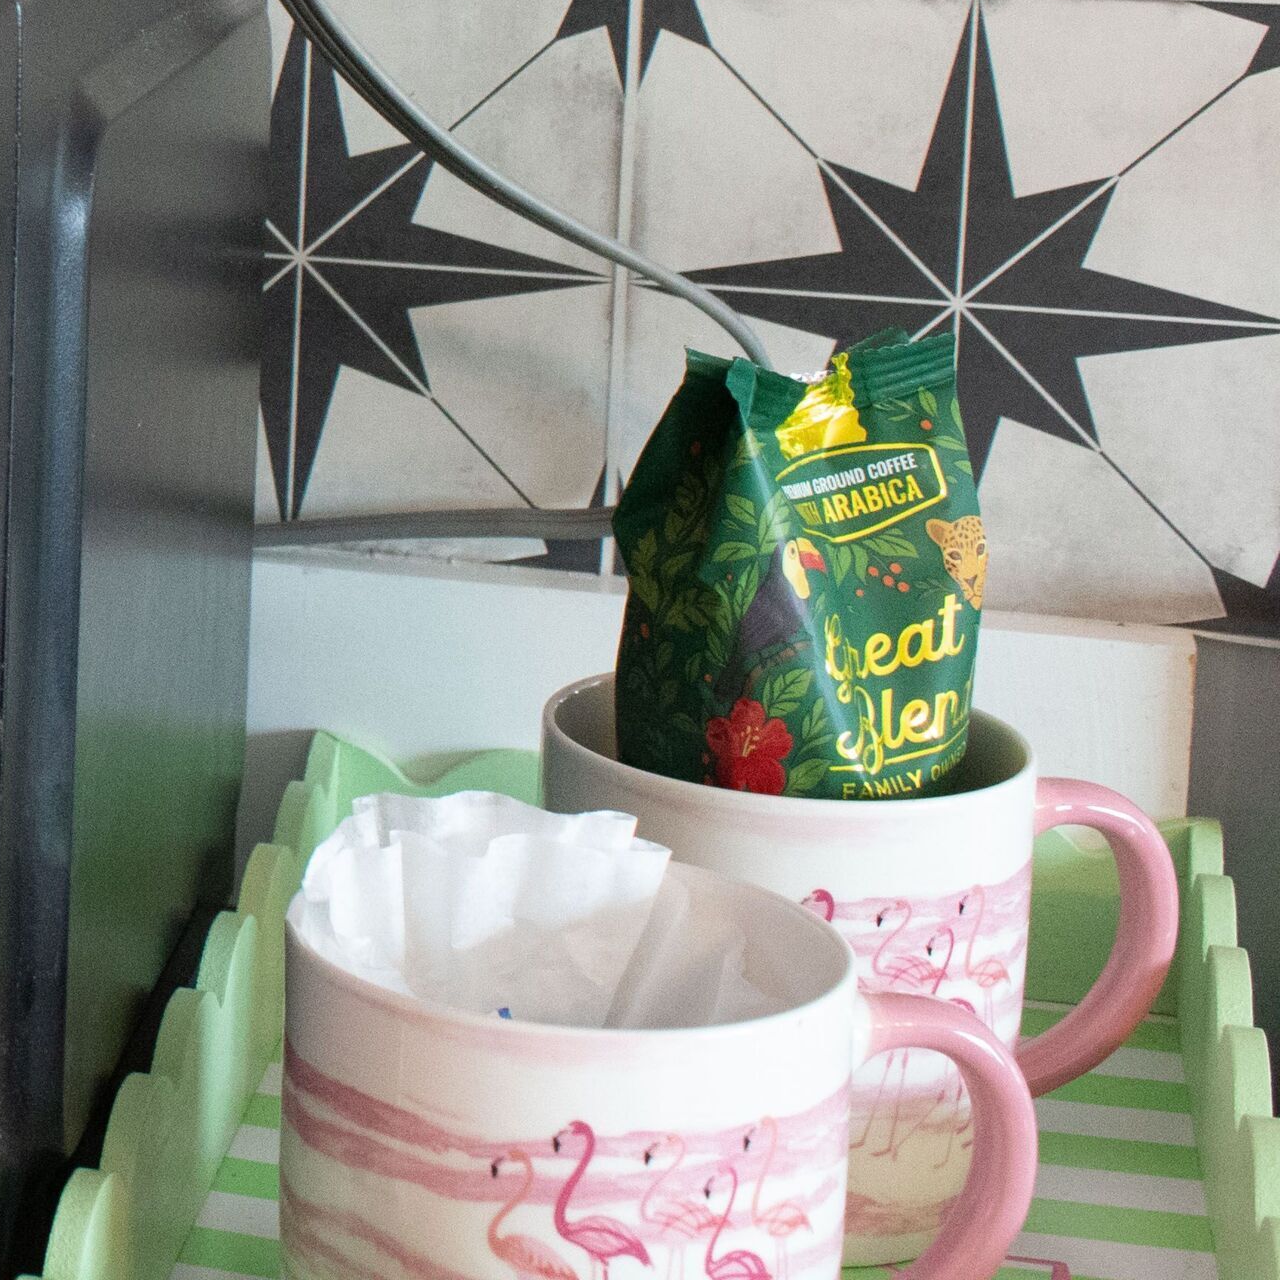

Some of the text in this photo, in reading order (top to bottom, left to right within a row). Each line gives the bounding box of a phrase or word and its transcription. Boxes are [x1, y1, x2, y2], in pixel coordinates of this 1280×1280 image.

[812, 468, 866, 495] GROUND
[867, 453, 918, 479] COFFEE
[822, 474, 924, 524] ARABICA
[824, 593, 965, 704] Great
[842, 769, 923, 800] FAMILY
